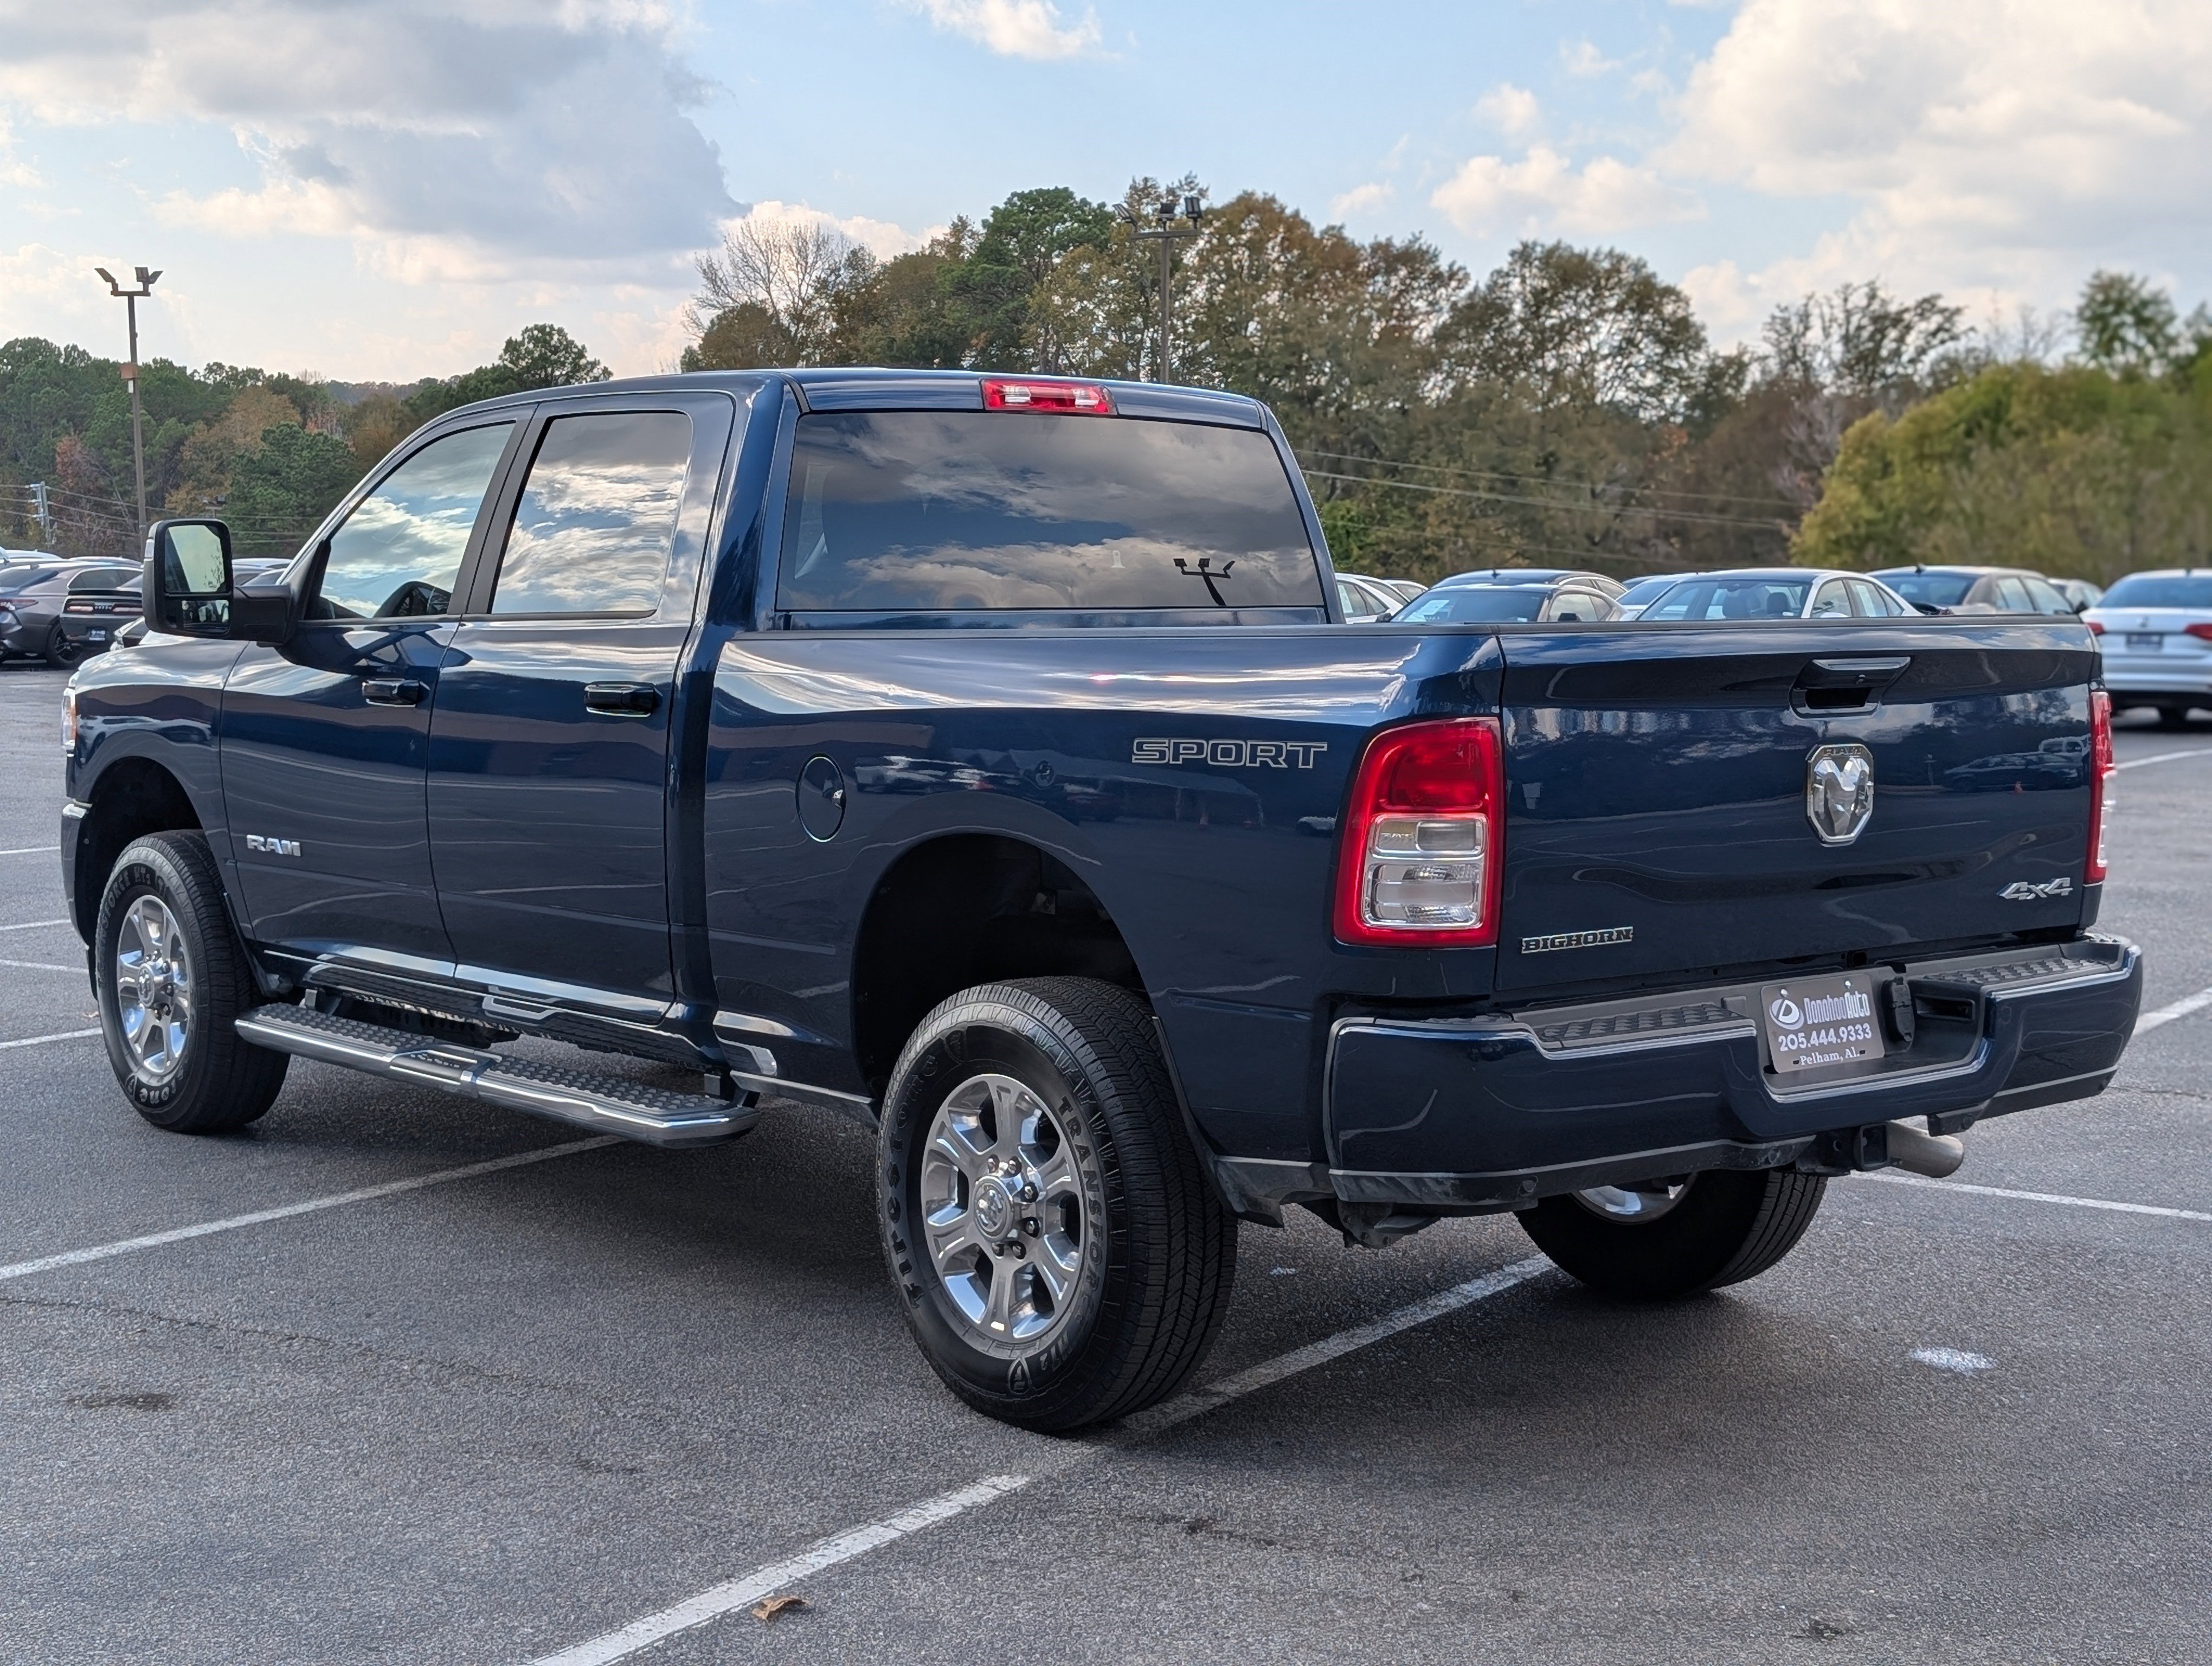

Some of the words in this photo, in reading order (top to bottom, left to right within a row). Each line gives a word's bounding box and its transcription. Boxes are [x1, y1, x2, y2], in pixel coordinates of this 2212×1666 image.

[1132, 737, 1328, 768] SPORT
[247, 835, 301, 856] RAM
[1521, 926, 1633, 953] BIGHORN
[1778, 1023, 1872, 1052] 205.444.9333
[1799, 1052, 1843, 1066] Pelham,
[1845, 1047, 1860, 1058] Al.
